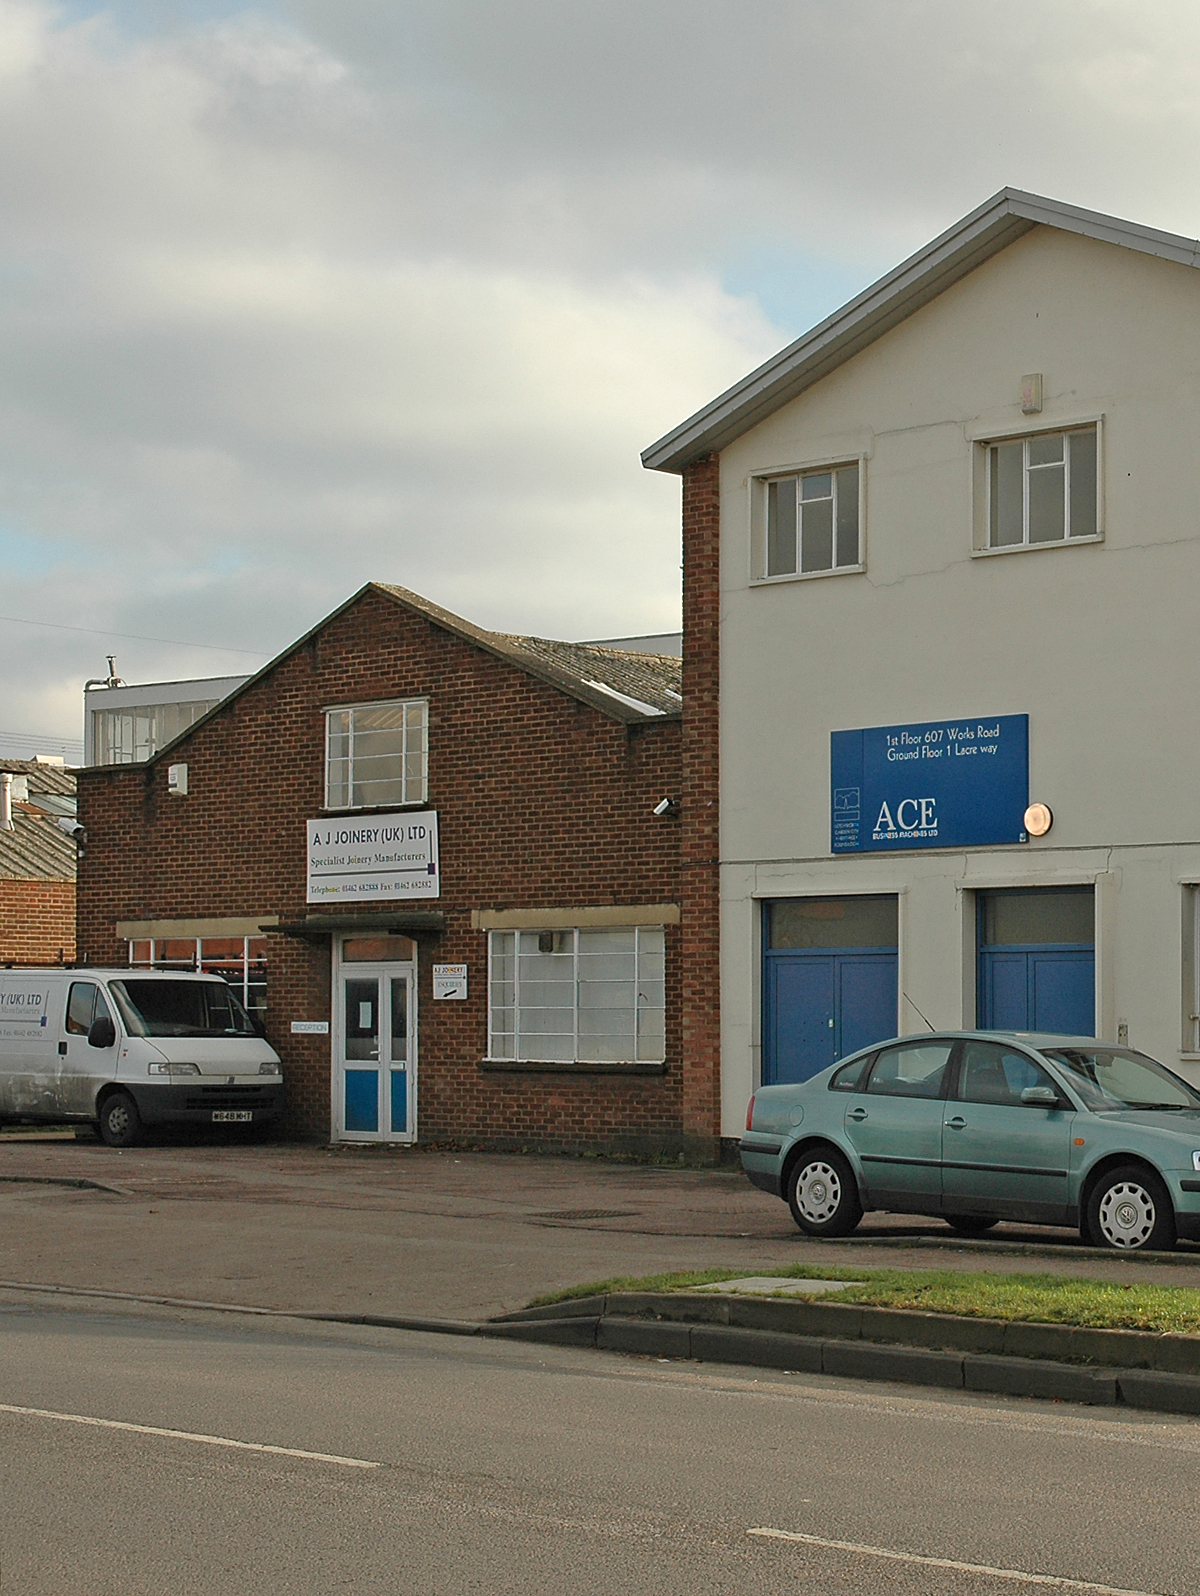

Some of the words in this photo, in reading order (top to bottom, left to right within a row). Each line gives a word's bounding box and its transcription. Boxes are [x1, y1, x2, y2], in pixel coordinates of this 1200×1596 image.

[886, 734, 899, 746] 1st
[901, 731, 922, 745] Floor
[924, 730, 944, 743] 607
[946, 727, 975, 740] Works
[977, 723, 1000, 738] Road
[887, 746, 919, 762] Ground
[921, 745, 943, 759] Floor
[946, 745, 951, 756] 1
[955, 743, 978, 756] Lacre
[980, 744, 998, 755] way
[873, 797, 939, 832] ACE
[313, 833, 322, 846] A
[325, 831, 331, 845] J
[334, 828, 380, 845] JOINERY
[381, 826, 405, 844] (UK)
[408, 825, 426, 840] LTD
[310, 855, 345, 868] Specialist
[346, 854, 372, 866] Joinery
[374, 852, 426, 863] Manufacturers
[310, 885, 341, 895] Telephone:
[342, 884, 357, 893] 01462
[380, 883, 393, 891] Fax:
[7, 993, 25, 1006] (UK)
[27, 993, 42, 1006] LTD
